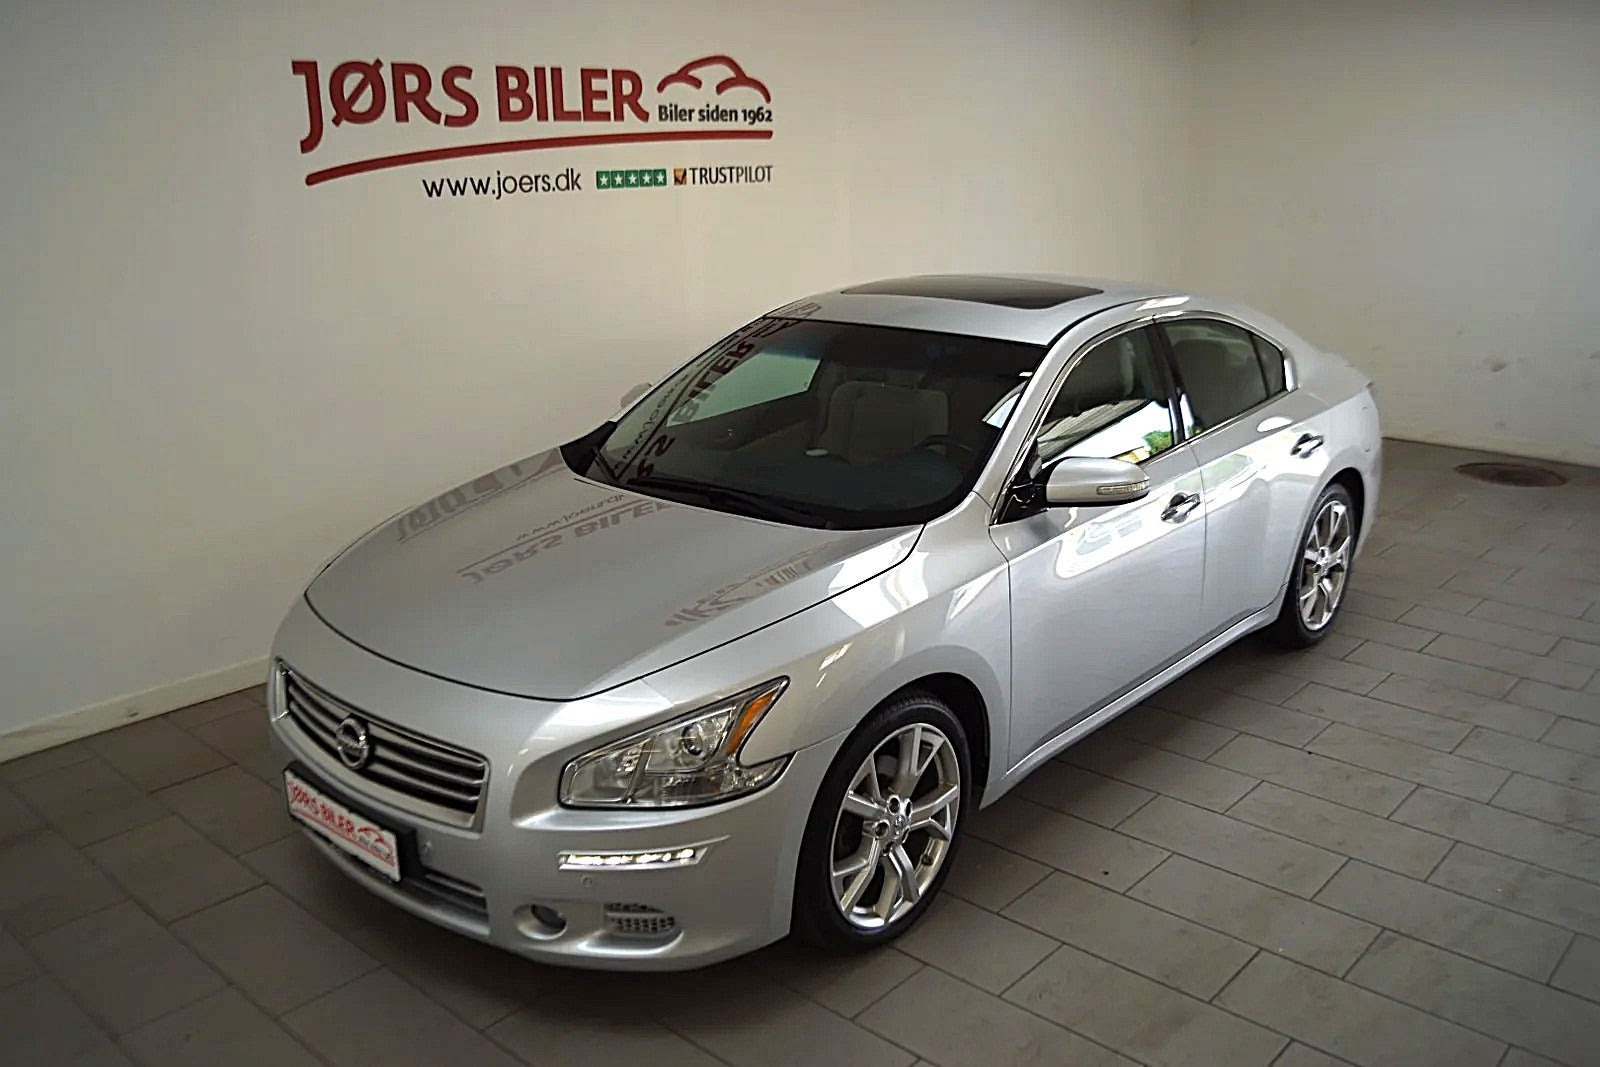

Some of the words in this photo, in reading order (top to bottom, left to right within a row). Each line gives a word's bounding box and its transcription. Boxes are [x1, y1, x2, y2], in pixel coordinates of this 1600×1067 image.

[292, 58, 480, 155] JØRS
[495, 64, 650, 123] BILER
[657, 102, 696, 122] Biler
[697, 103, 739, 123] siden
[740, 106, 773, 126] 1962
[421, 167, 582, 200] www.joers.dk
[688, 165, 774, 185] TRUSTPILOT
